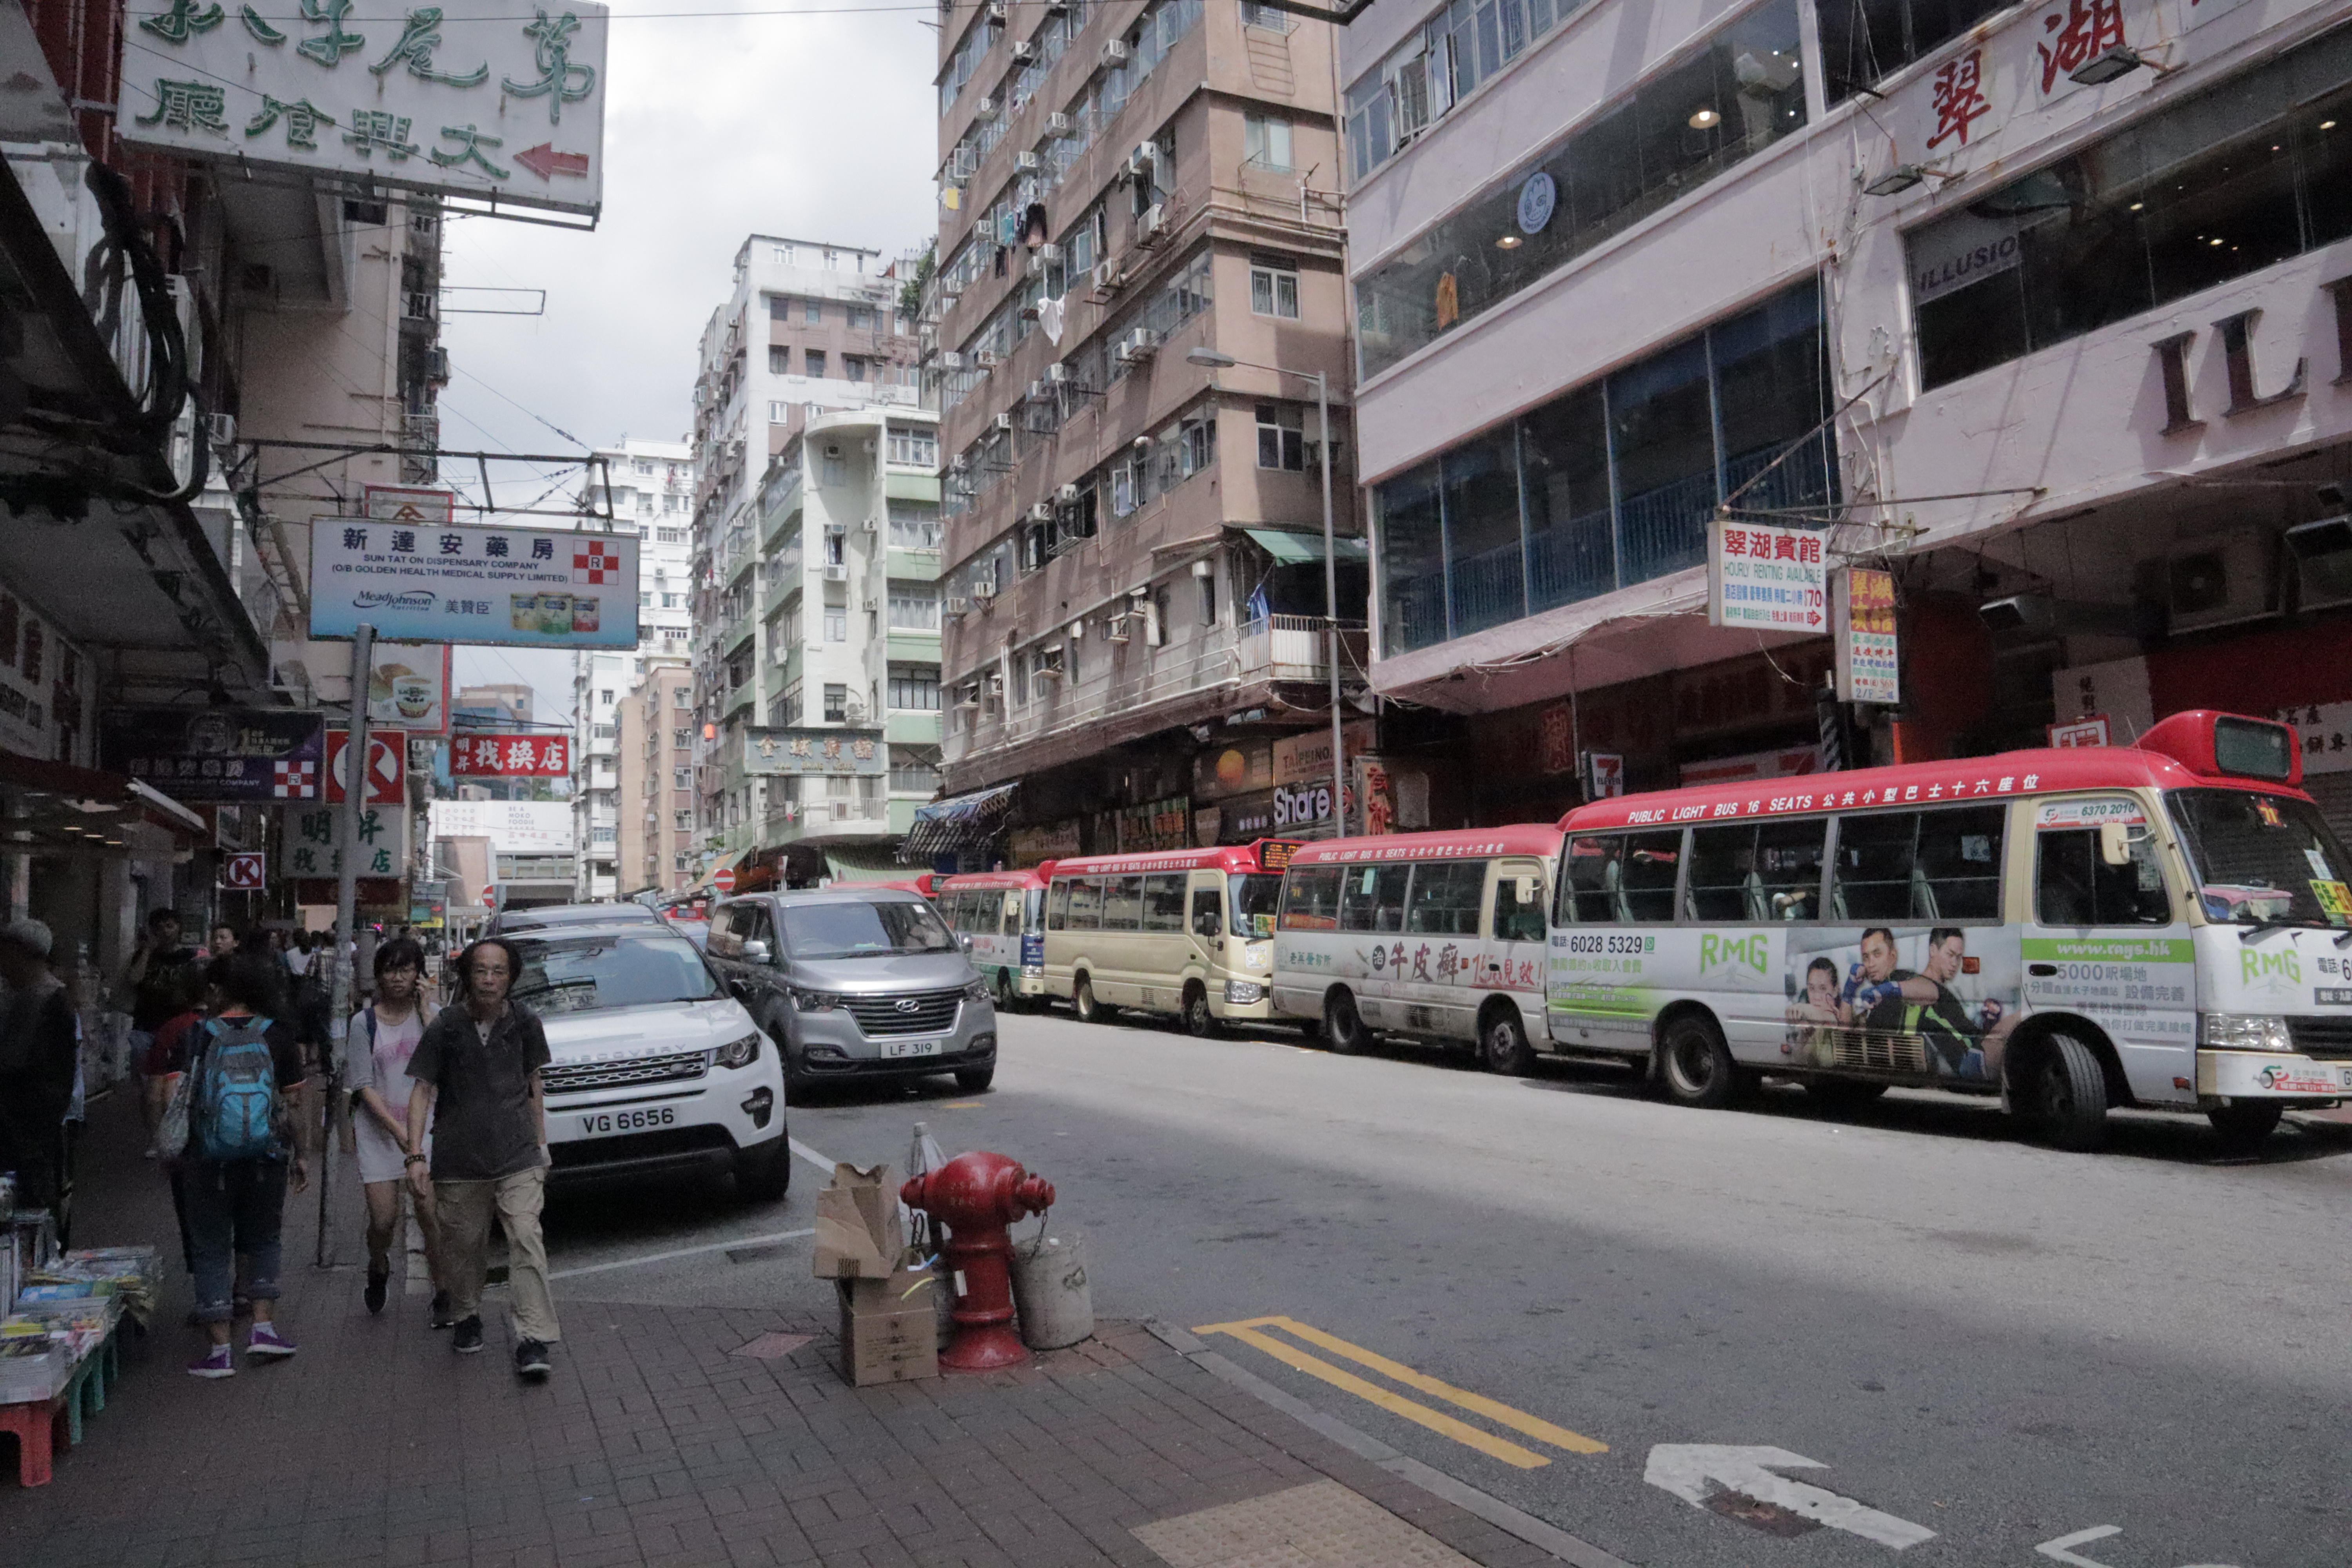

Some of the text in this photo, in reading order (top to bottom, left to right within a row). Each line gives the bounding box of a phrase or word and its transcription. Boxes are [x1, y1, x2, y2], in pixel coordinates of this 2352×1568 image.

[343, 528, 554, 559] 新達安藥房
[1725, 529, 1821, 563] 翠湖賓館
[364, 554, 386, 563] SUN
[389, 555, 407, 564] TAT
[427, 557, 489, 567] DISPENSARY
[491, 561, 539, 570] COMPANY
[1724, 562, 1821, 583] HOURLY RENTING AVAILABLE
[332, 564, 568, 583] (O/B GOLDEN HEALTH MEDICAL SUPPLY LIMITED)
[1850, 571, 1893, 601] 翠湖
[1804, 589, 1822, 608] $70
[1856, 688, 1873, 699] 2/F
[456, 737, 470, 771] 明昇
[475, 739, 564, 771] 找換店
[1597, 777, 1621, 785] ELEVEN
[1274, 786, 1330, 825] Share
[1627, 774, 2038, 824] PUBLIC LIGHT BUS 16 SEATS 公共小型巴士十六座位
[2082, 802, 2135, 816] 6370 2010
[1318, 843, 1504, 861] PUBLIC LIGHT BUS 16 SEATS 公共小型巴士十六座位
[1571, 936, 1603, 953] 6028
[1608, 936, 1642, 954] 5329
[1700, 933, 1769, 975] RMG
[2239, 948, 2302, 985] RMG
[2125, 985, 2185, 1002] 設備完善
[555, 1043, 687, 1065] DISCOVERY
[890, 1042, 933, 1056] LF 319
[583, 1107, 675, 1134] VG 6656
